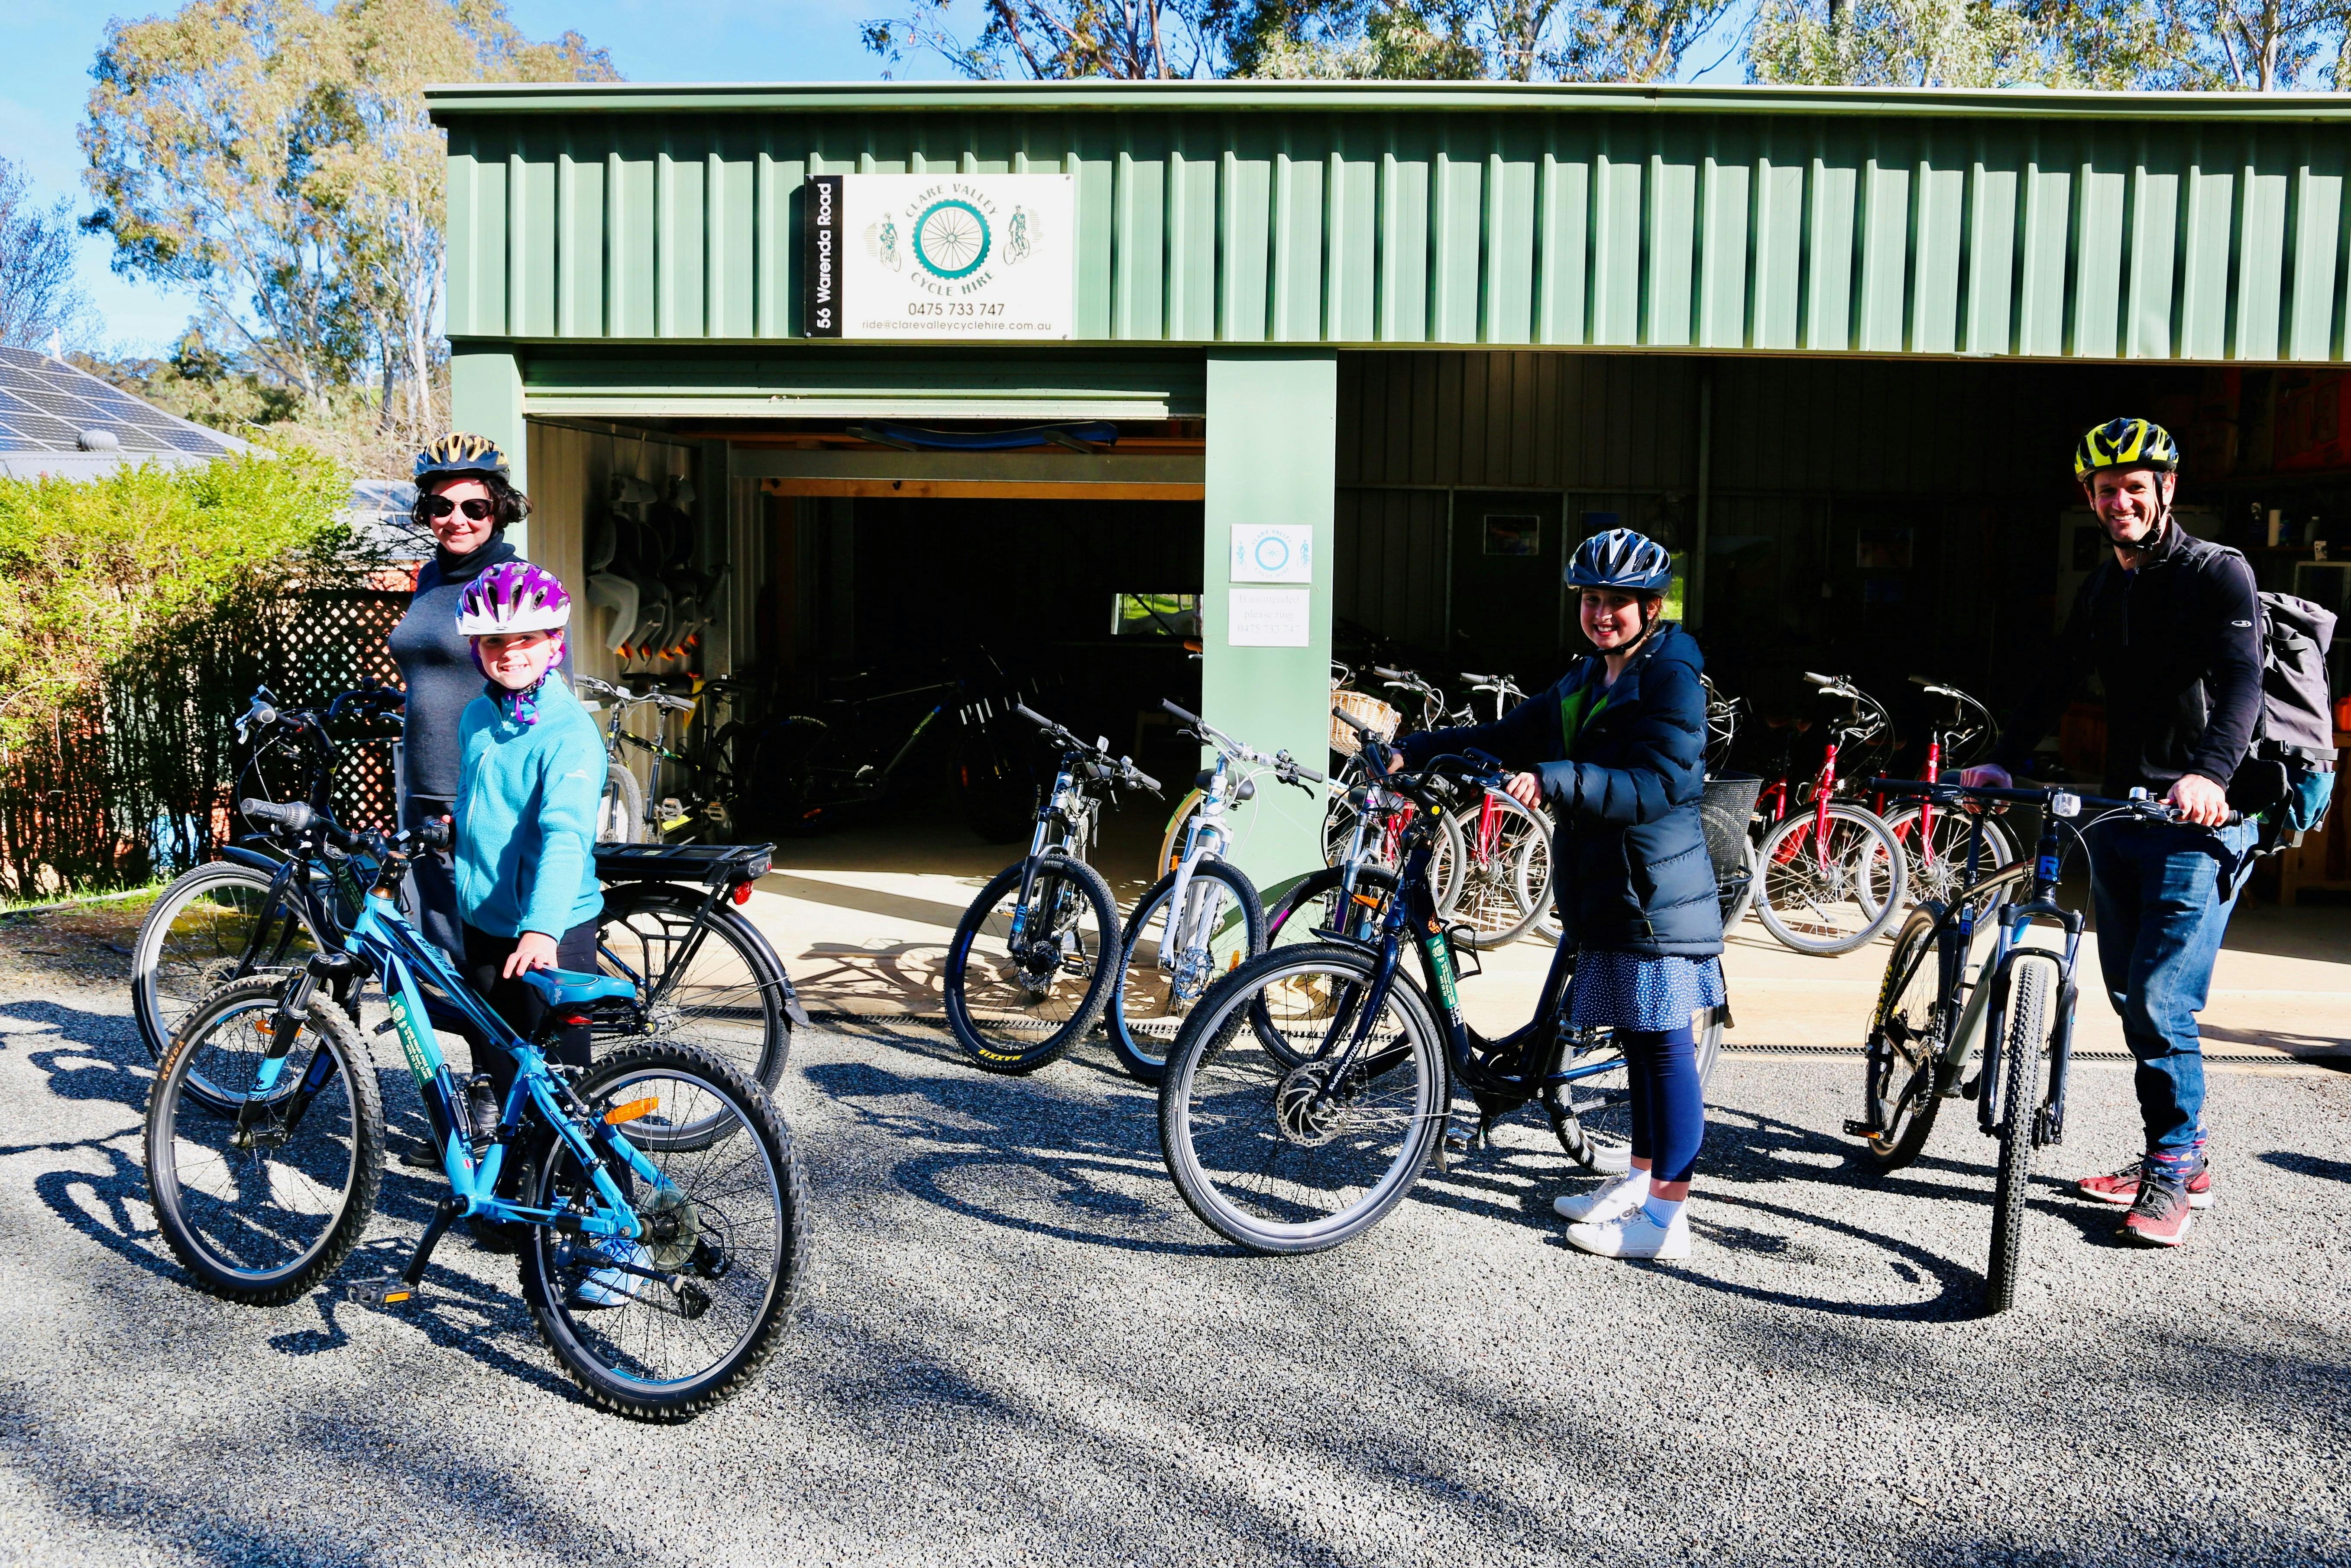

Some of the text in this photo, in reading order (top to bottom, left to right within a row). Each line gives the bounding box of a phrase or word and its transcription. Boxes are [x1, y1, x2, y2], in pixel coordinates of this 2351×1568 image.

[906, 183, 999, 217] CLARE VALLEY
[817, 183, 831, 329] 56 Warenda Road
[911, 269, 994, 296] CYCLE HIRE
[909, 303, 1005, 316] 0475 733 747
[862, 320, 1051, 331] ride@clarevalleycyclehire.com.au
[1251, 529, 1292, 545] CLARE VALLEY
[1237, 625, 1260, 633] 0475
[1264, 625, 1279, 633] 733
[1244, 609, 1294, 621] please ring
[1964, 908, 1971, 917] XL
[1116, 949, 1130, 993] ALEXRIMS
[1874, 965, 1892, 1026] MAXXIS
[162, 1040, 185, 1081] KENDA
[407, 1025, 434, 1078] CLARE VALLEY CYCLE HIRE
[407, 1035, 417, 1055] Warenda
[420, 1066, 429, 1080] CLARE
[978, 1049, 1023, 1061] MAXXIS
[1328, 1039, 1363, 1092] SMARTMOTION
